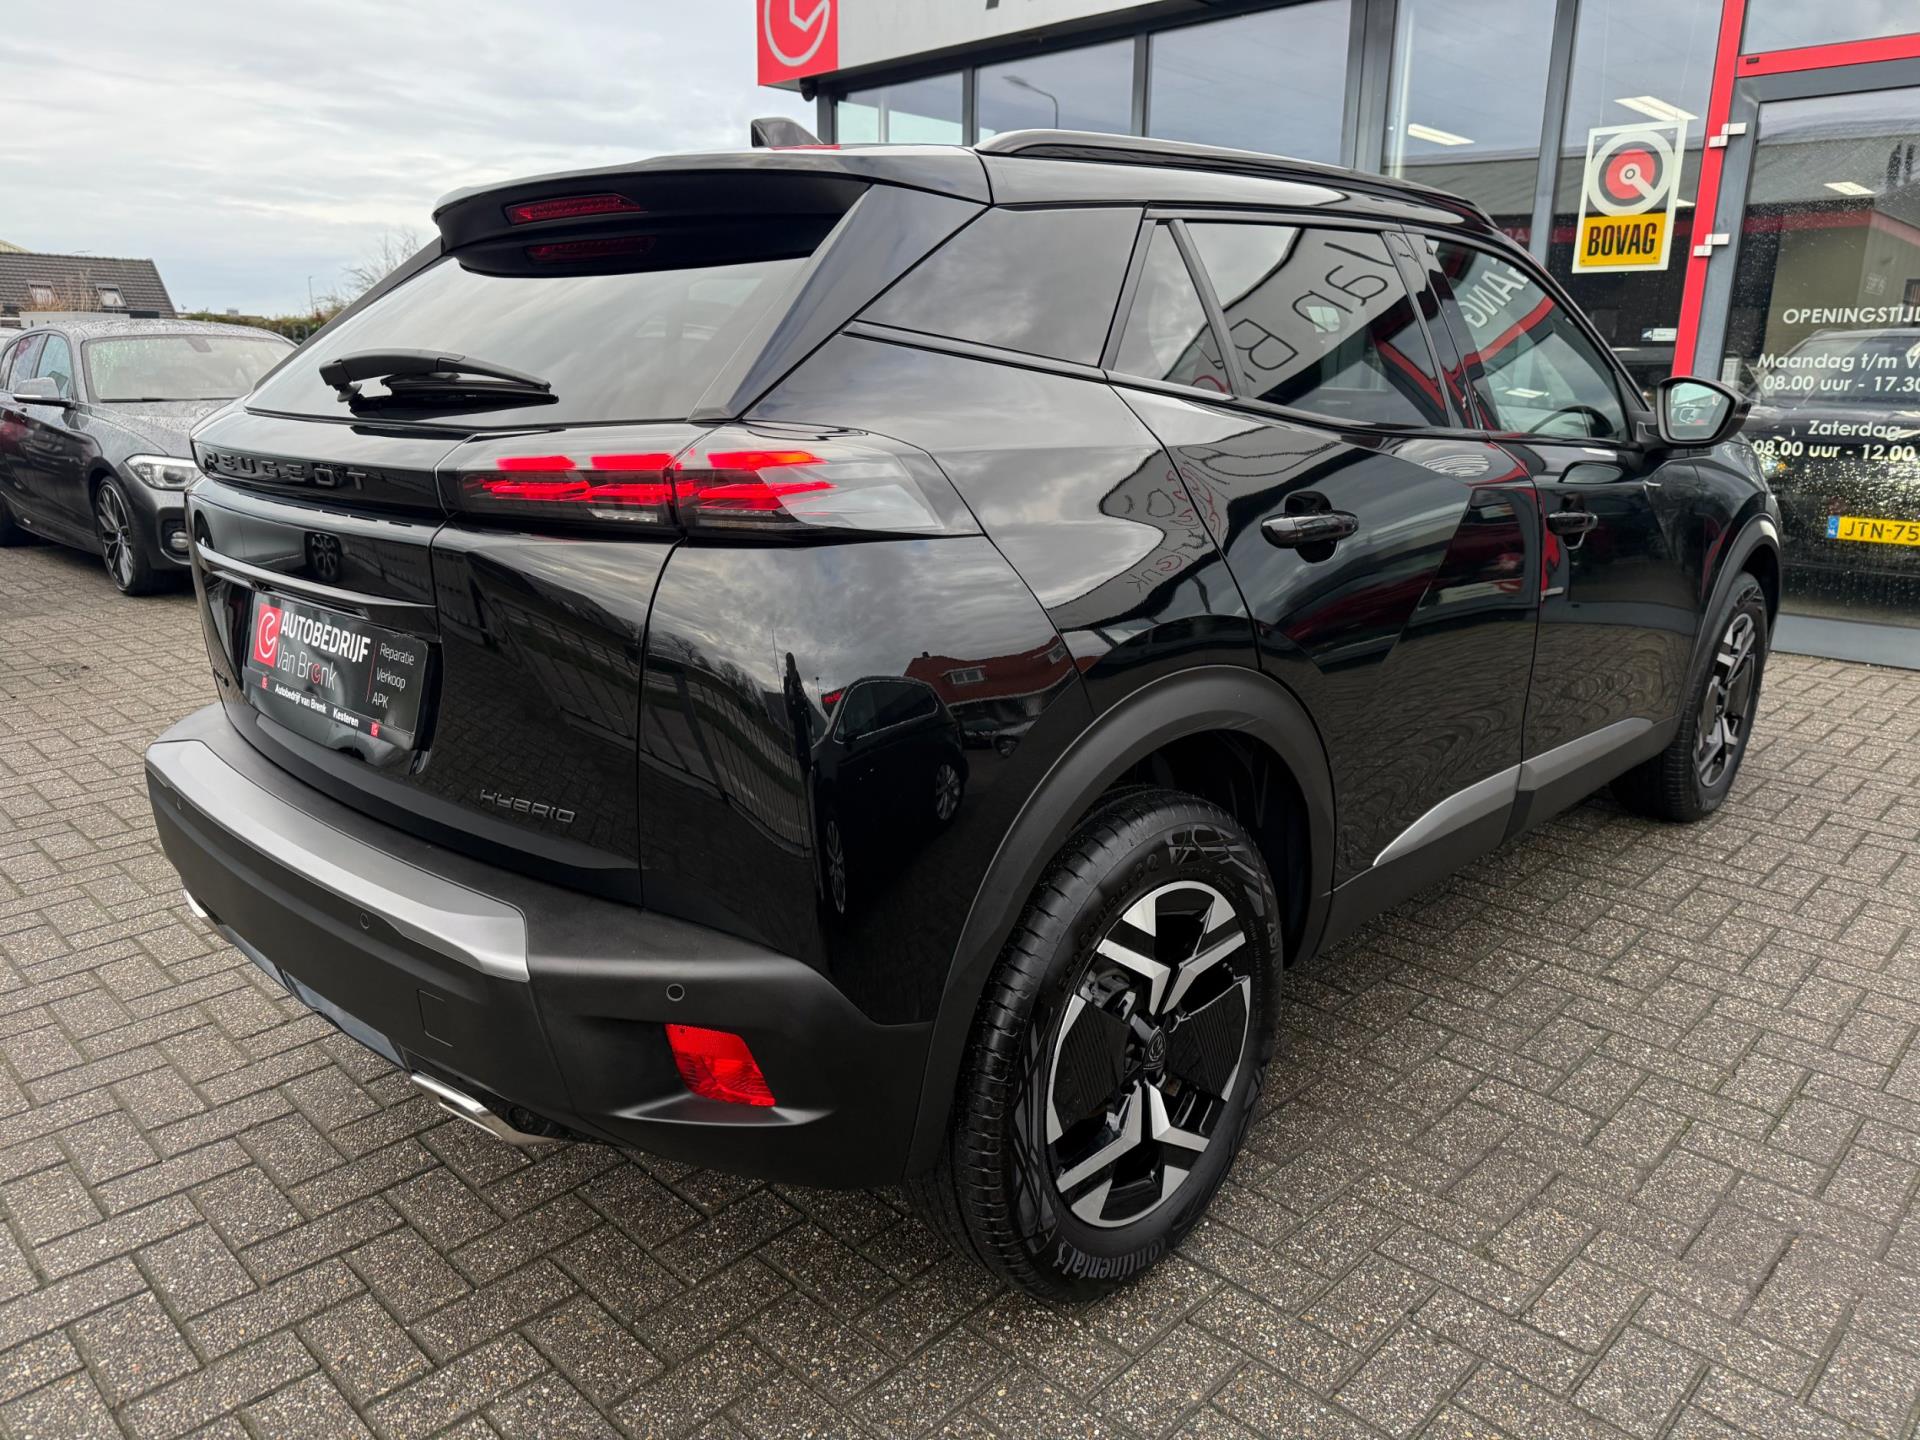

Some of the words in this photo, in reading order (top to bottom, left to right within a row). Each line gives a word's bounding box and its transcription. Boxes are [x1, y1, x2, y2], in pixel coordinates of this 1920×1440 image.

[1586, 222, 1658, 257] BOVAG
[1757, 353, 1855, 372] Maandag
[1861, 352, 1898, 370] t/m
[1763, 375, 1815, 392] 08.00
[1819, 377, 1853, 392] uur
[1874, 376, 1920, 393] 17.30
[1808, 420, 1901, 441] Zaterdag
[1753, 440, 1804, 456] 08.00
[1808, 444, 1841, 458] uur
[1862, 444, 1917, 462] 12.00
[204, 451, 367, 491] PEUGEOT
[280, 611, 371, 663] AUTOBEDRIJF
[277, 642, 296, 674] Van
[379, 642, 415, 666] Reparatie
[376, 667, 406, 692] Verkoop
[371, 692, 389, 709] APK
[333, 707, 359, 728] Kesteren
[480, 789, 576, 823] HYBRID
[1062, 1236, 1167, 1280] Continental
